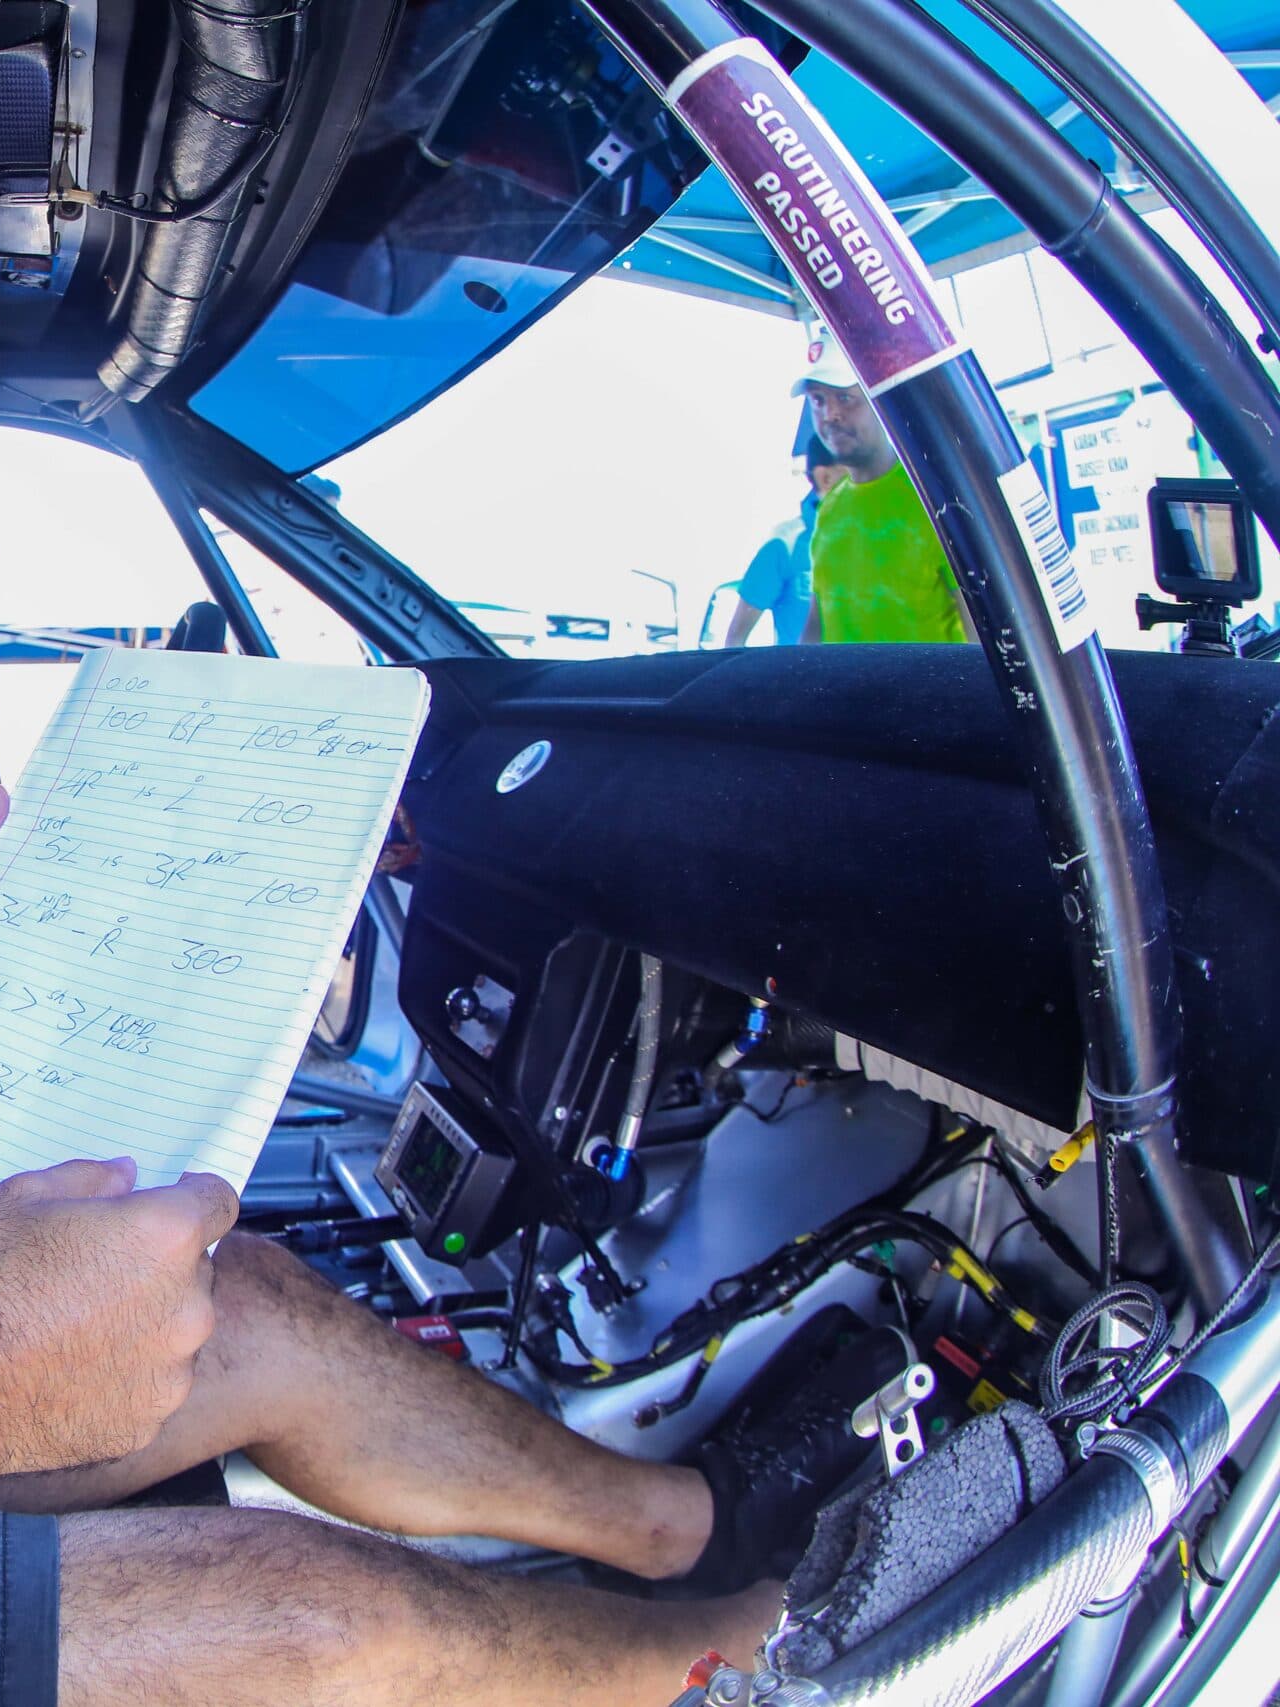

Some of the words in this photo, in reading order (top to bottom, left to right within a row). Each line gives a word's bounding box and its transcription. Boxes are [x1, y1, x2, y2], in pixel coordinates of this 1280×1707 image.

[740, 91, 916, 327] SCRUTINEERING
[753, 171, 845, 291] PASSED
[97, 705, 150, 730] 100
[239, 723, 300, 752] 100
[237, 794, 314, 824] 100
[245, 878, 320, 907] 100
[170, 938, 243, 975] 300
